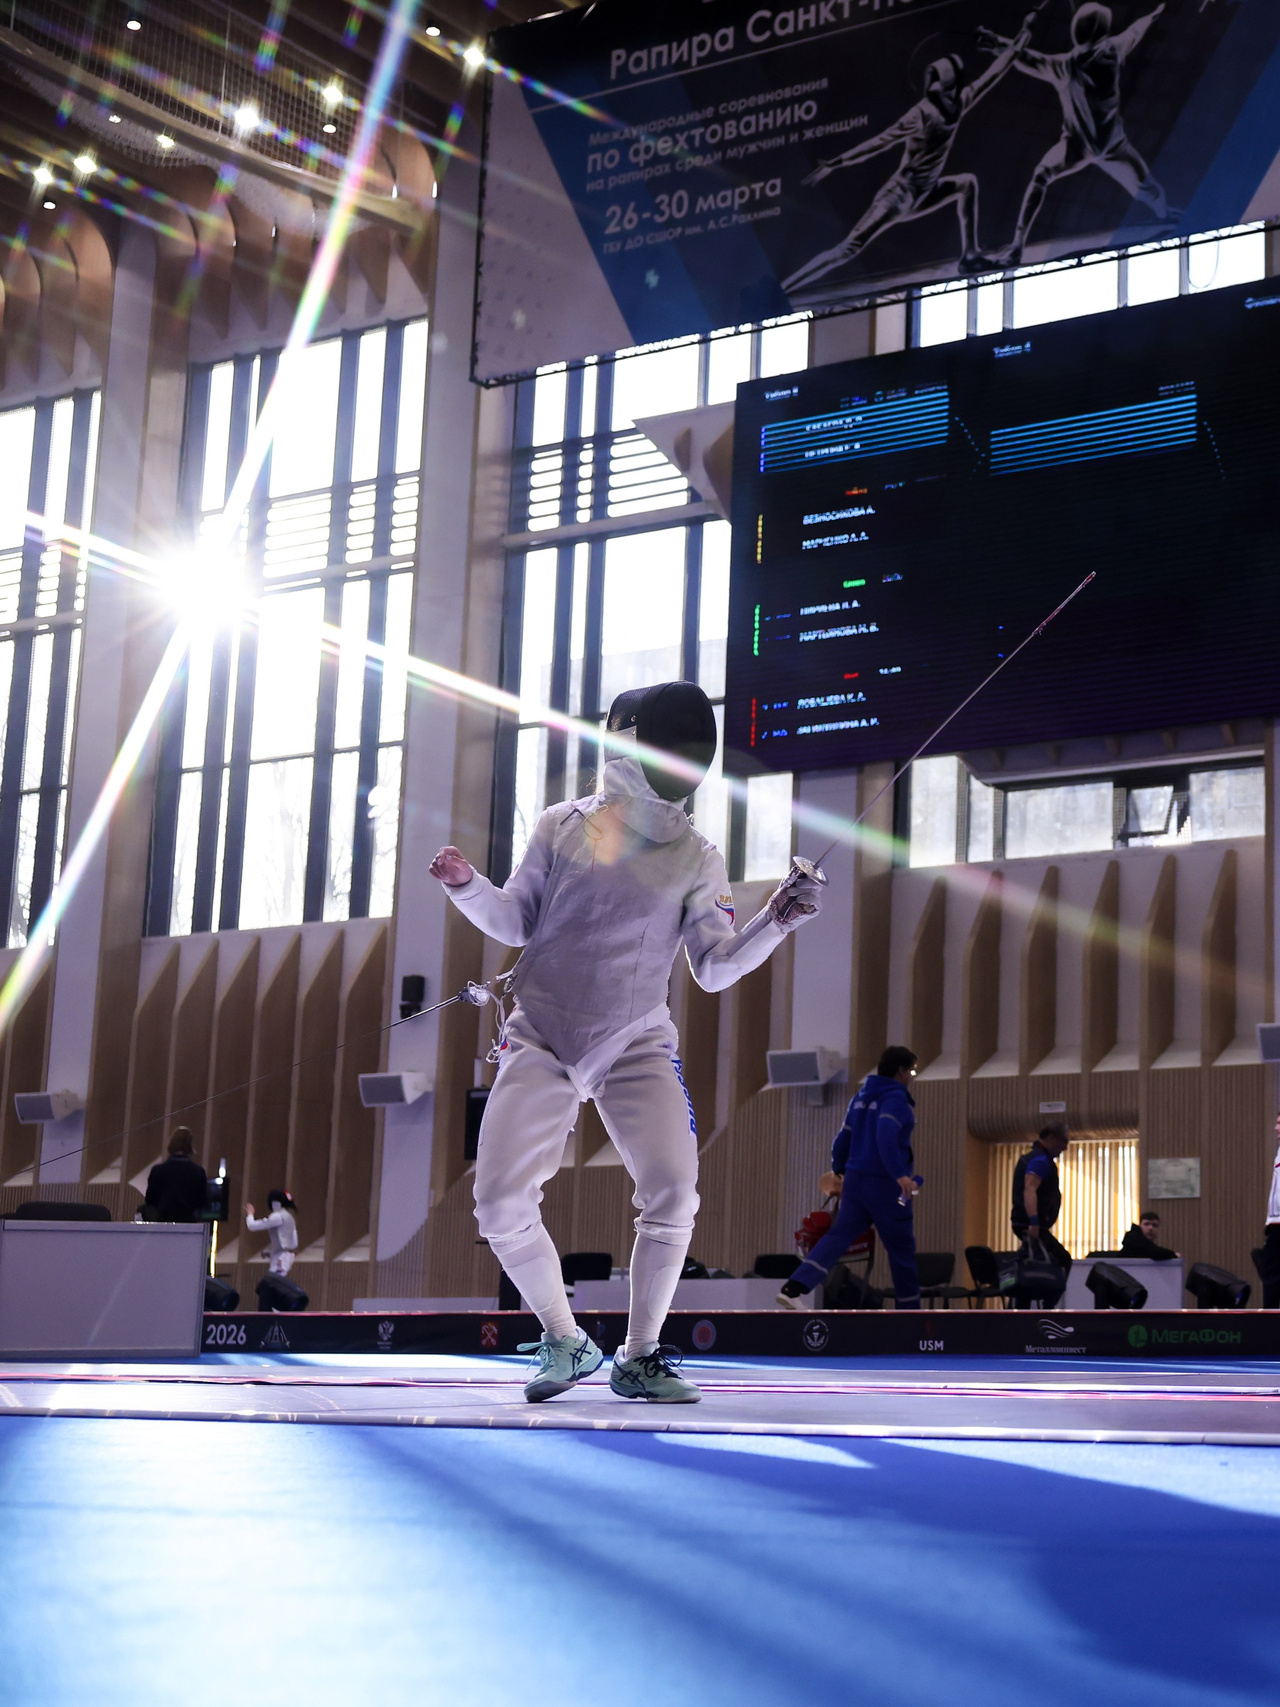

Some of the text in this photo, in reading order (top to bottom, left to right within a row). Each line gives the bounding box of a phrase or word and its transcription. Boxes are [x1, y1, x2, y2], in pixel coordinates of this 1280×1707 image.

[610, 0, 912, 80] Рапира Санкт-
[587, 100, 818, 174] по фехтованию
[588, 77, 829, 147] Международные соревнования
[586, 114, 868, 192] на рапирах среди мужчин и женщин
[604, 177, 782, 235] 26-30 марта
[205, 1323, 247, 1346] 2026
[919, 1339, 944, 1351] USM
